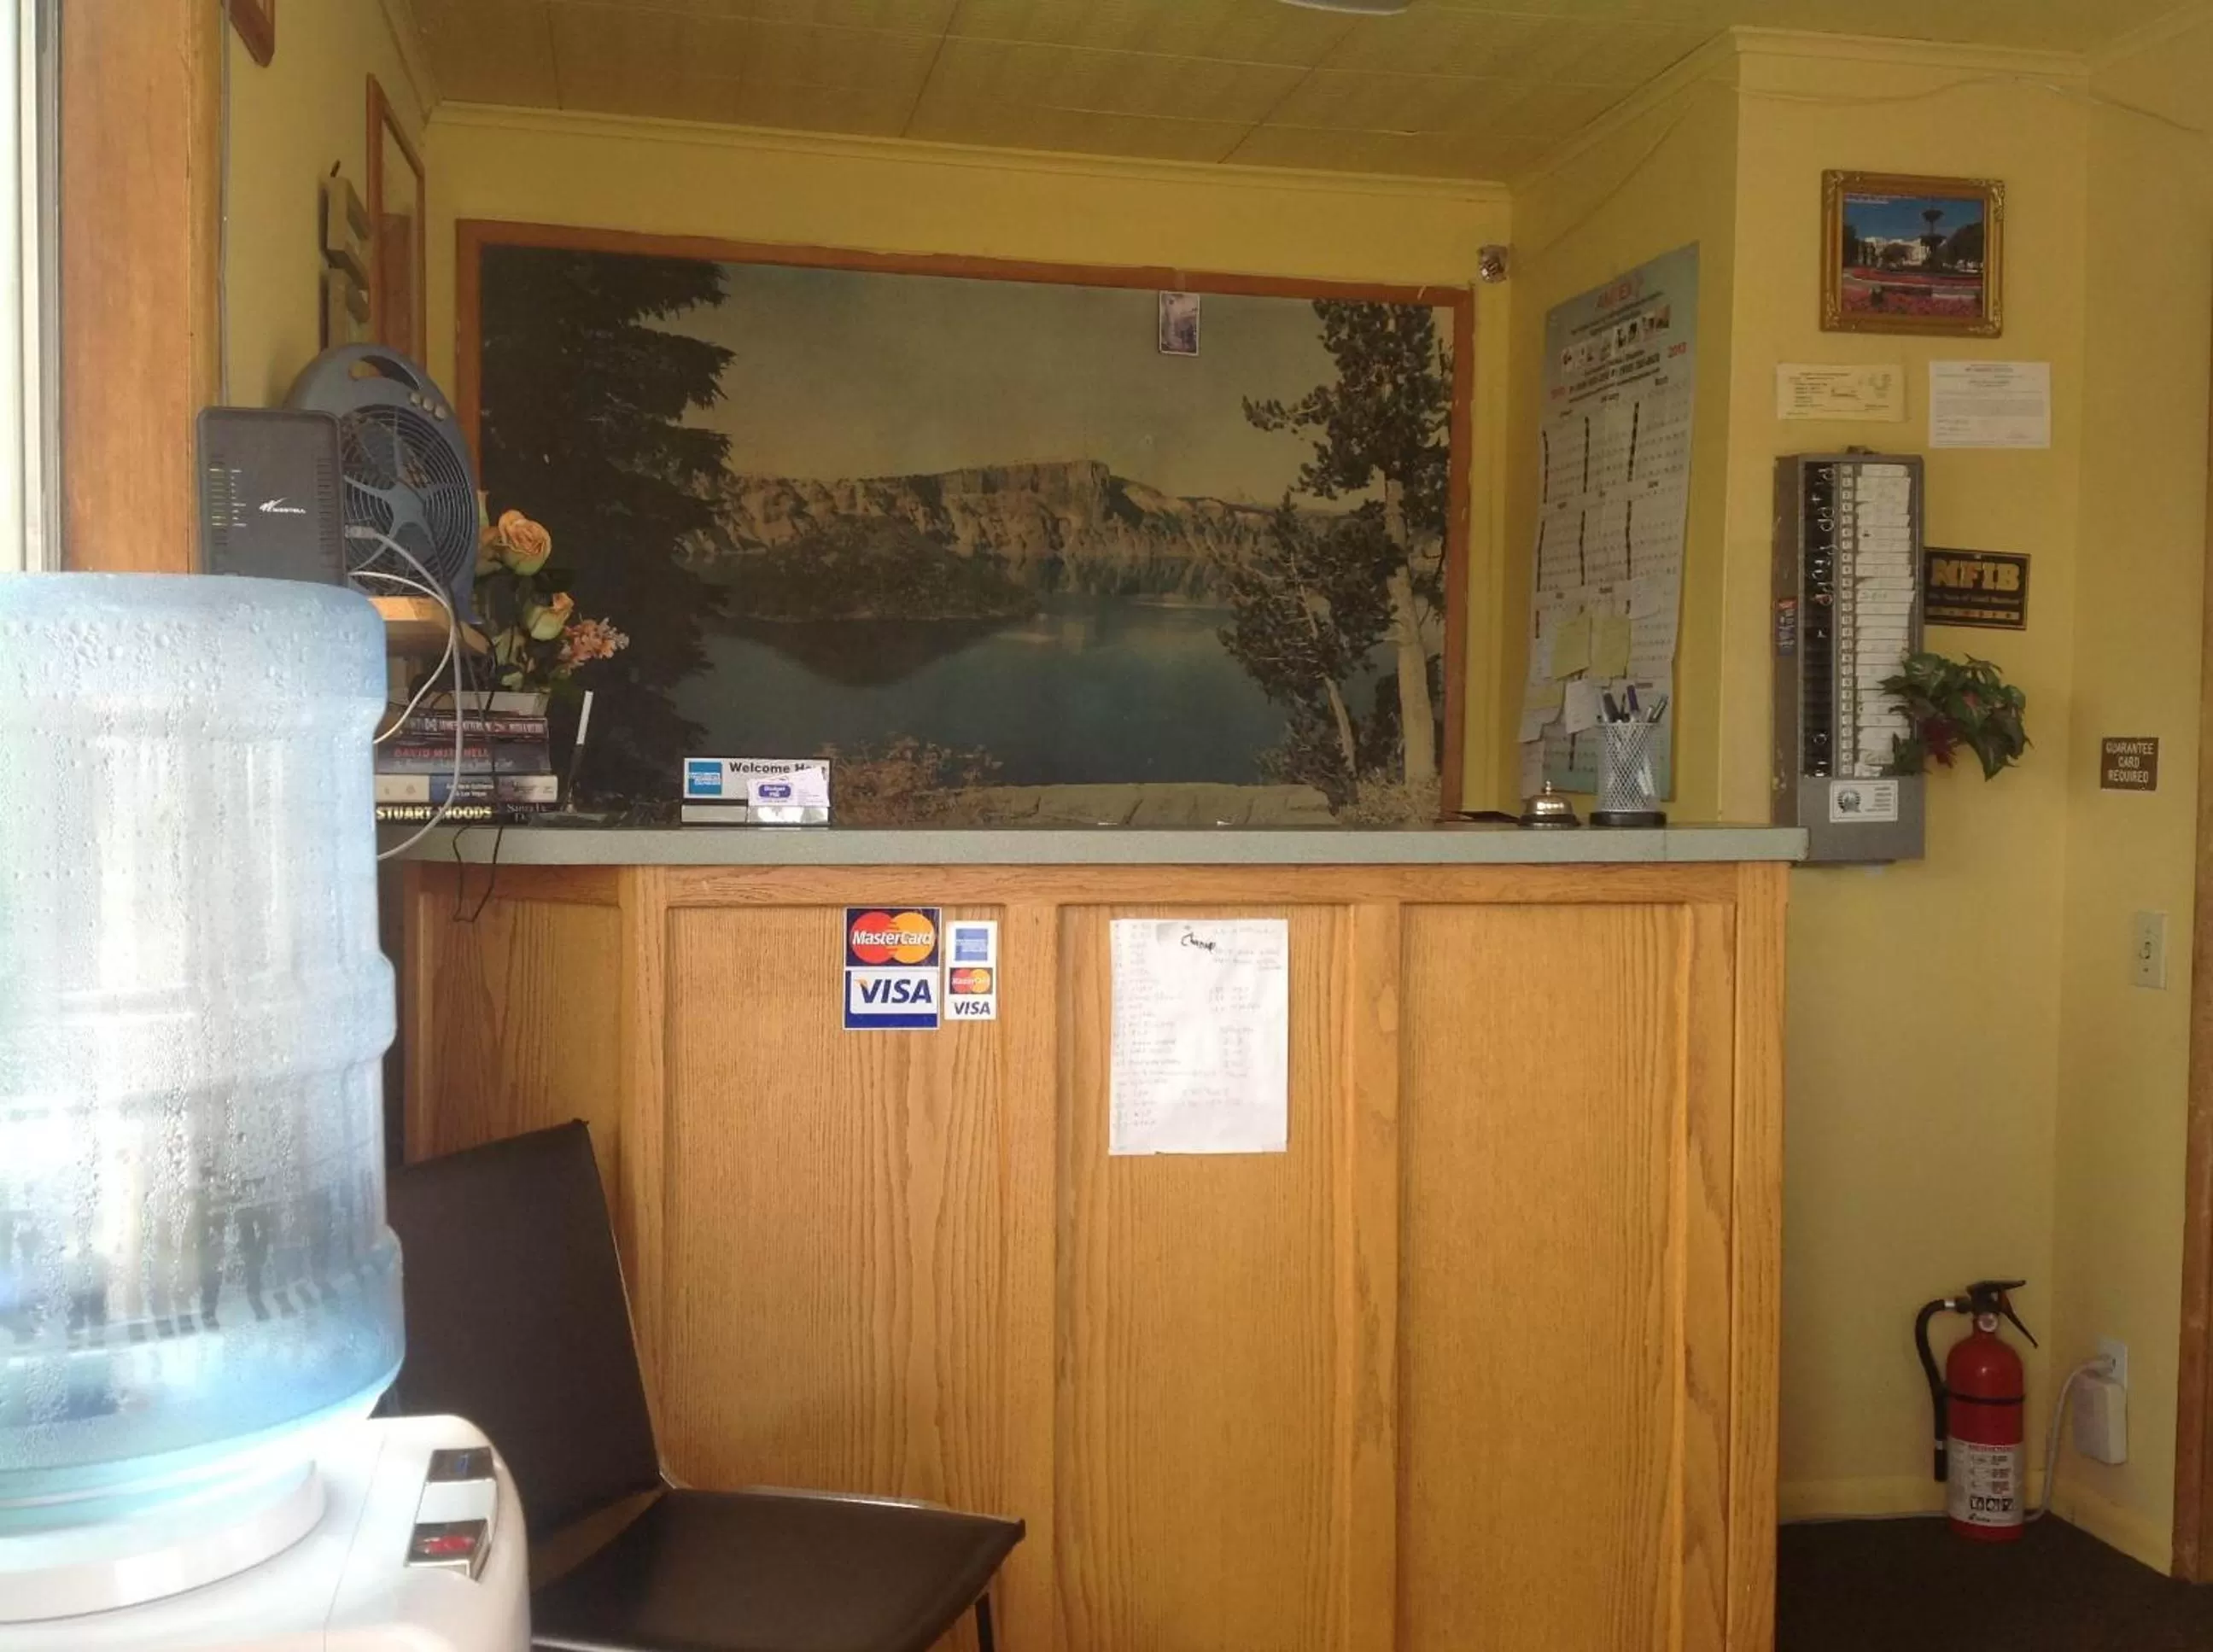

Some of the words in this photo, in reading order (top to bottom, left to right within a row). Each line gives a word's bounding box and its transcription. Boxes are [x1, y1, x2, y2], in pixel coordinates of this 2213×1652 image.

[1931, 557, 2020, 591] NFIB
[394, 748, 430, 759] DAVID
[729, 762, 791, 773] Welcome
[2117, 756, 2140, 769] CARD
[376, 806, 433, 820] STUART
[852, 930, 934, 945] MasterCard
[857, 979, 932, 1004] VISA
[954, 1001, 991, 1015] VISA
